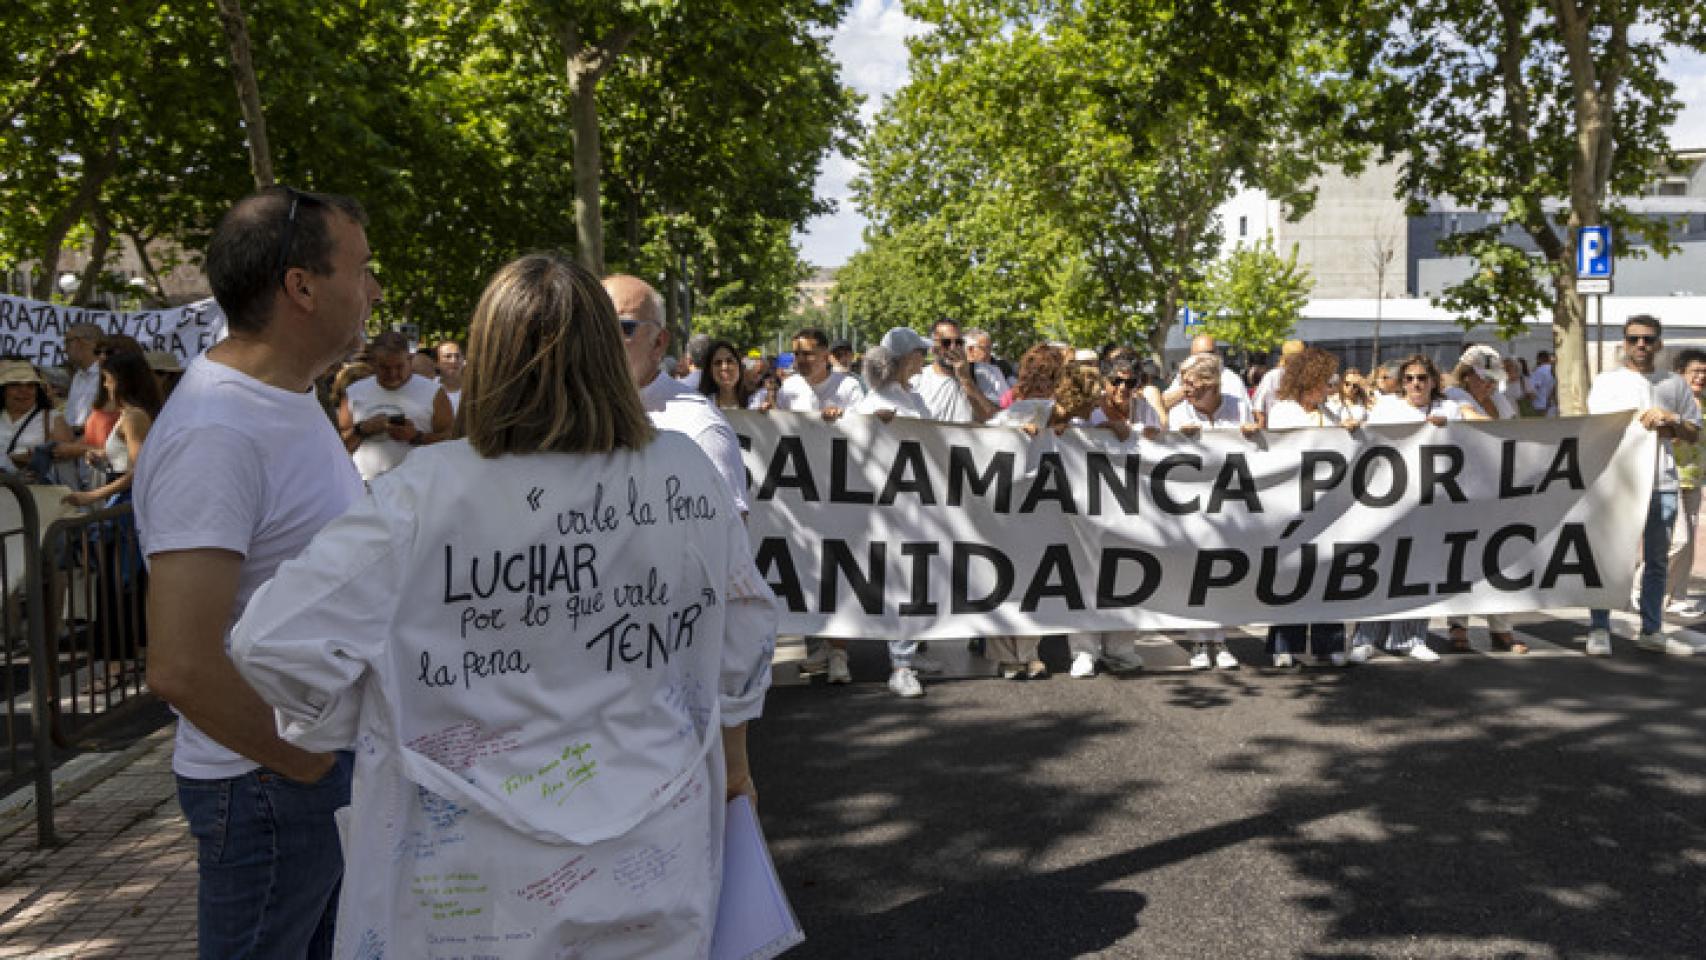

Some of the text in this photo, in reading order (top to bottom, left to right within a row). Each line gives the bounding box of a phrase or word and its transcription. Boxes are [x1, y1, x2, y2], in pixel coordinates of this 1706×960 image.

[1583, 232, 1603, 273] P
[1300, 445, 1467, 512] POR
[1499, 437, 1585, 499] LA
[557, 481, 619, 535] vale
[626, 476, 657, 526] la
[444, 543, 599, 604] LUCHAR
[755, 519, 1603, 616] ANIDAD PÚBLICA
[520, 594, 550, 627] lo
[566, 591, 605, 632] que
[613, 566, 671, 608] vale
[418, 650, 457, 687] la
